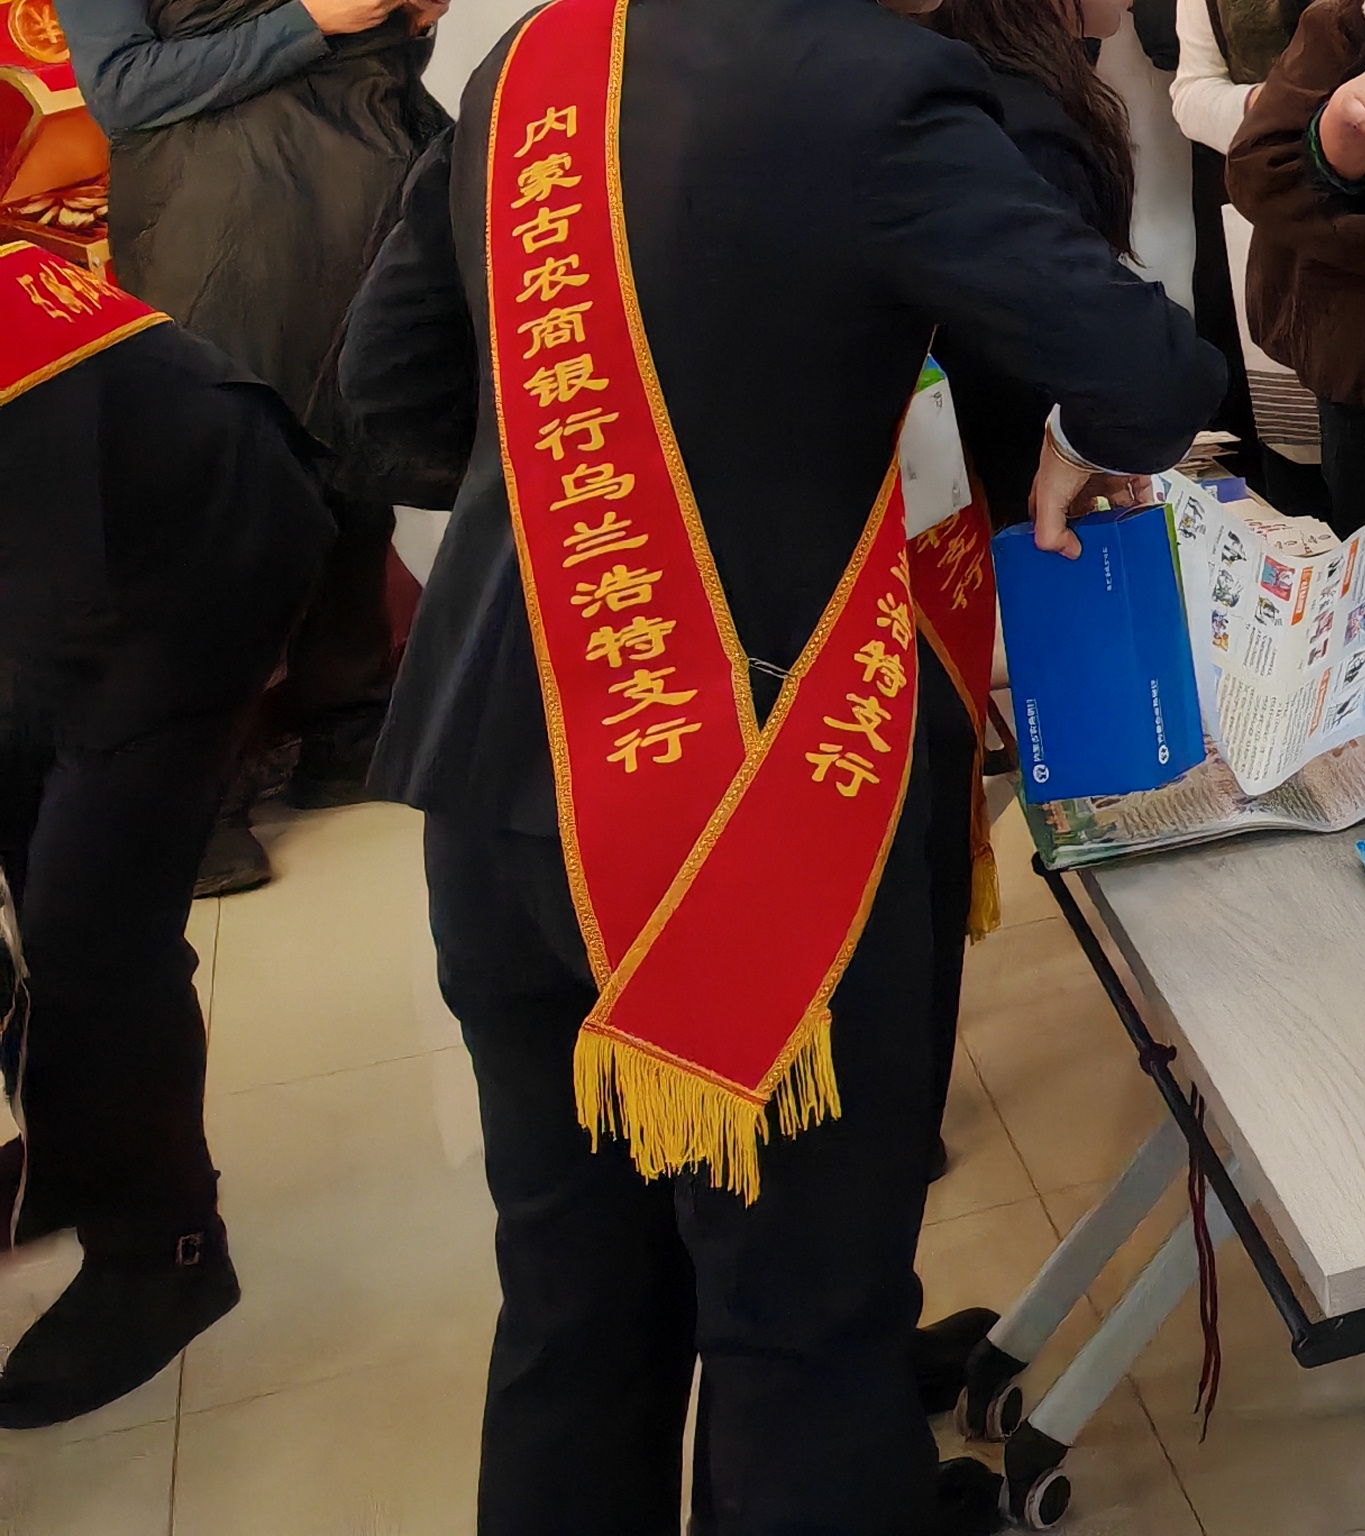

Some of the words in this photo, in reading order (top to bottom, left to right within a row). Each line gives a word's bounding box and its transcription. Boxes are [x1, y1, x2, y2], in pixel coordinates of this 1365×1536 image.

[511, 104, 702, 773] 内蒙古农商银行乌兰浩特支行
[804, 549, 913, 797] 浩特支行
